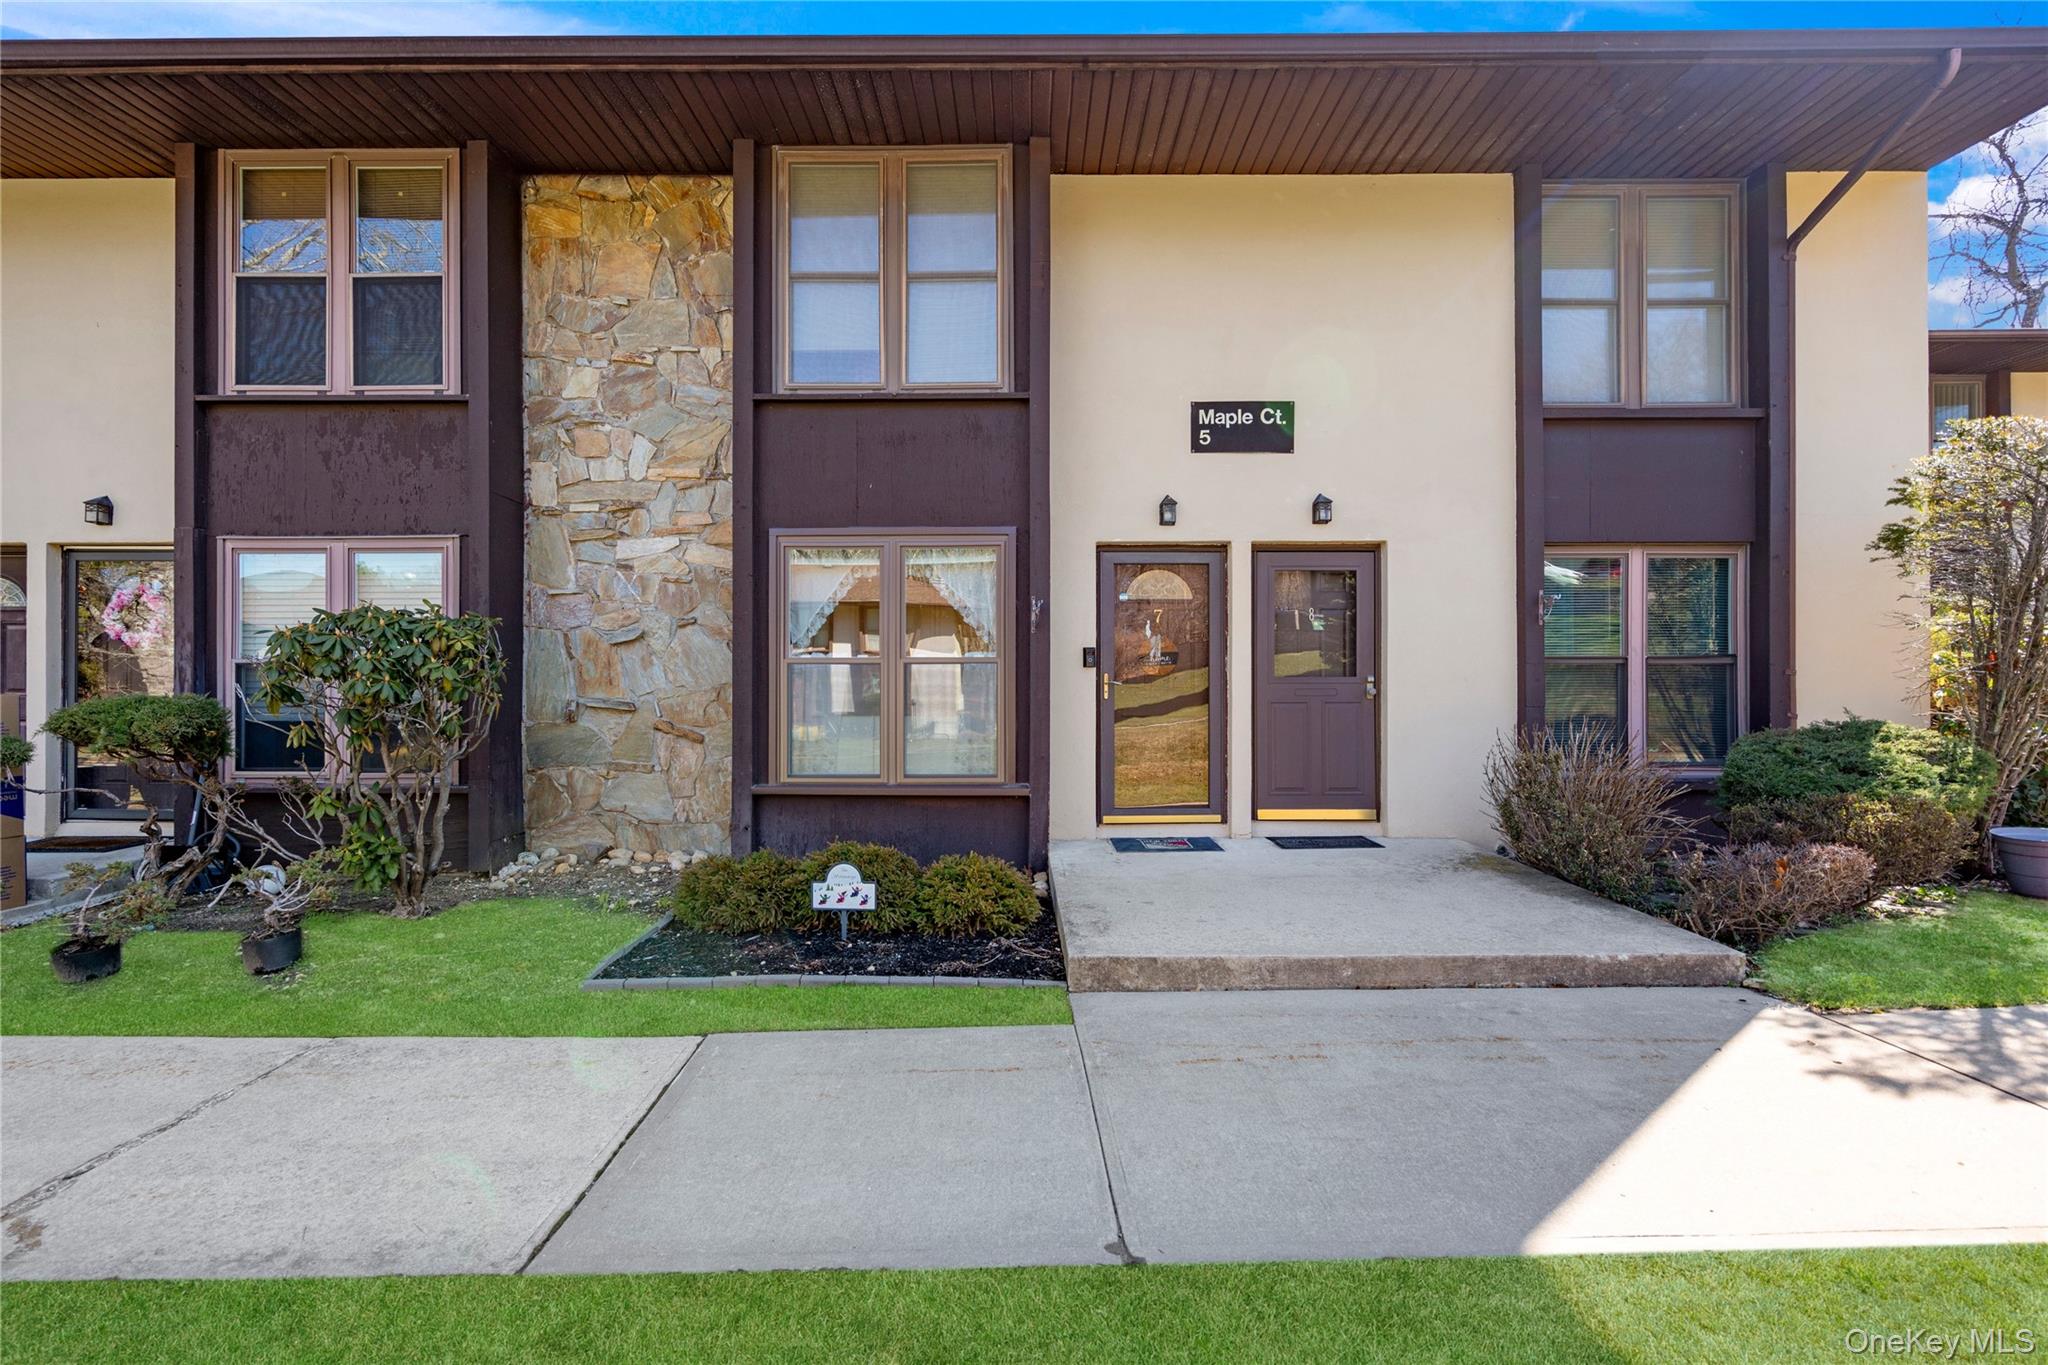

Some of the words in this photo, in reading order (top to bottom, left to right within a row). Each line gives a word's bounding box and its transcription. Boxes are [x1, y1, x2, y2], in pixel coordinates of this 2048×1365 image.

[1199, 408, 1254, 428] Maple
[1260, 407, 1287, 425] Ct.
[1199, 429, 1211, 445] 5
[1153, 609, 1163, 624] 7
[1308, 607, 1315, 621] 8
